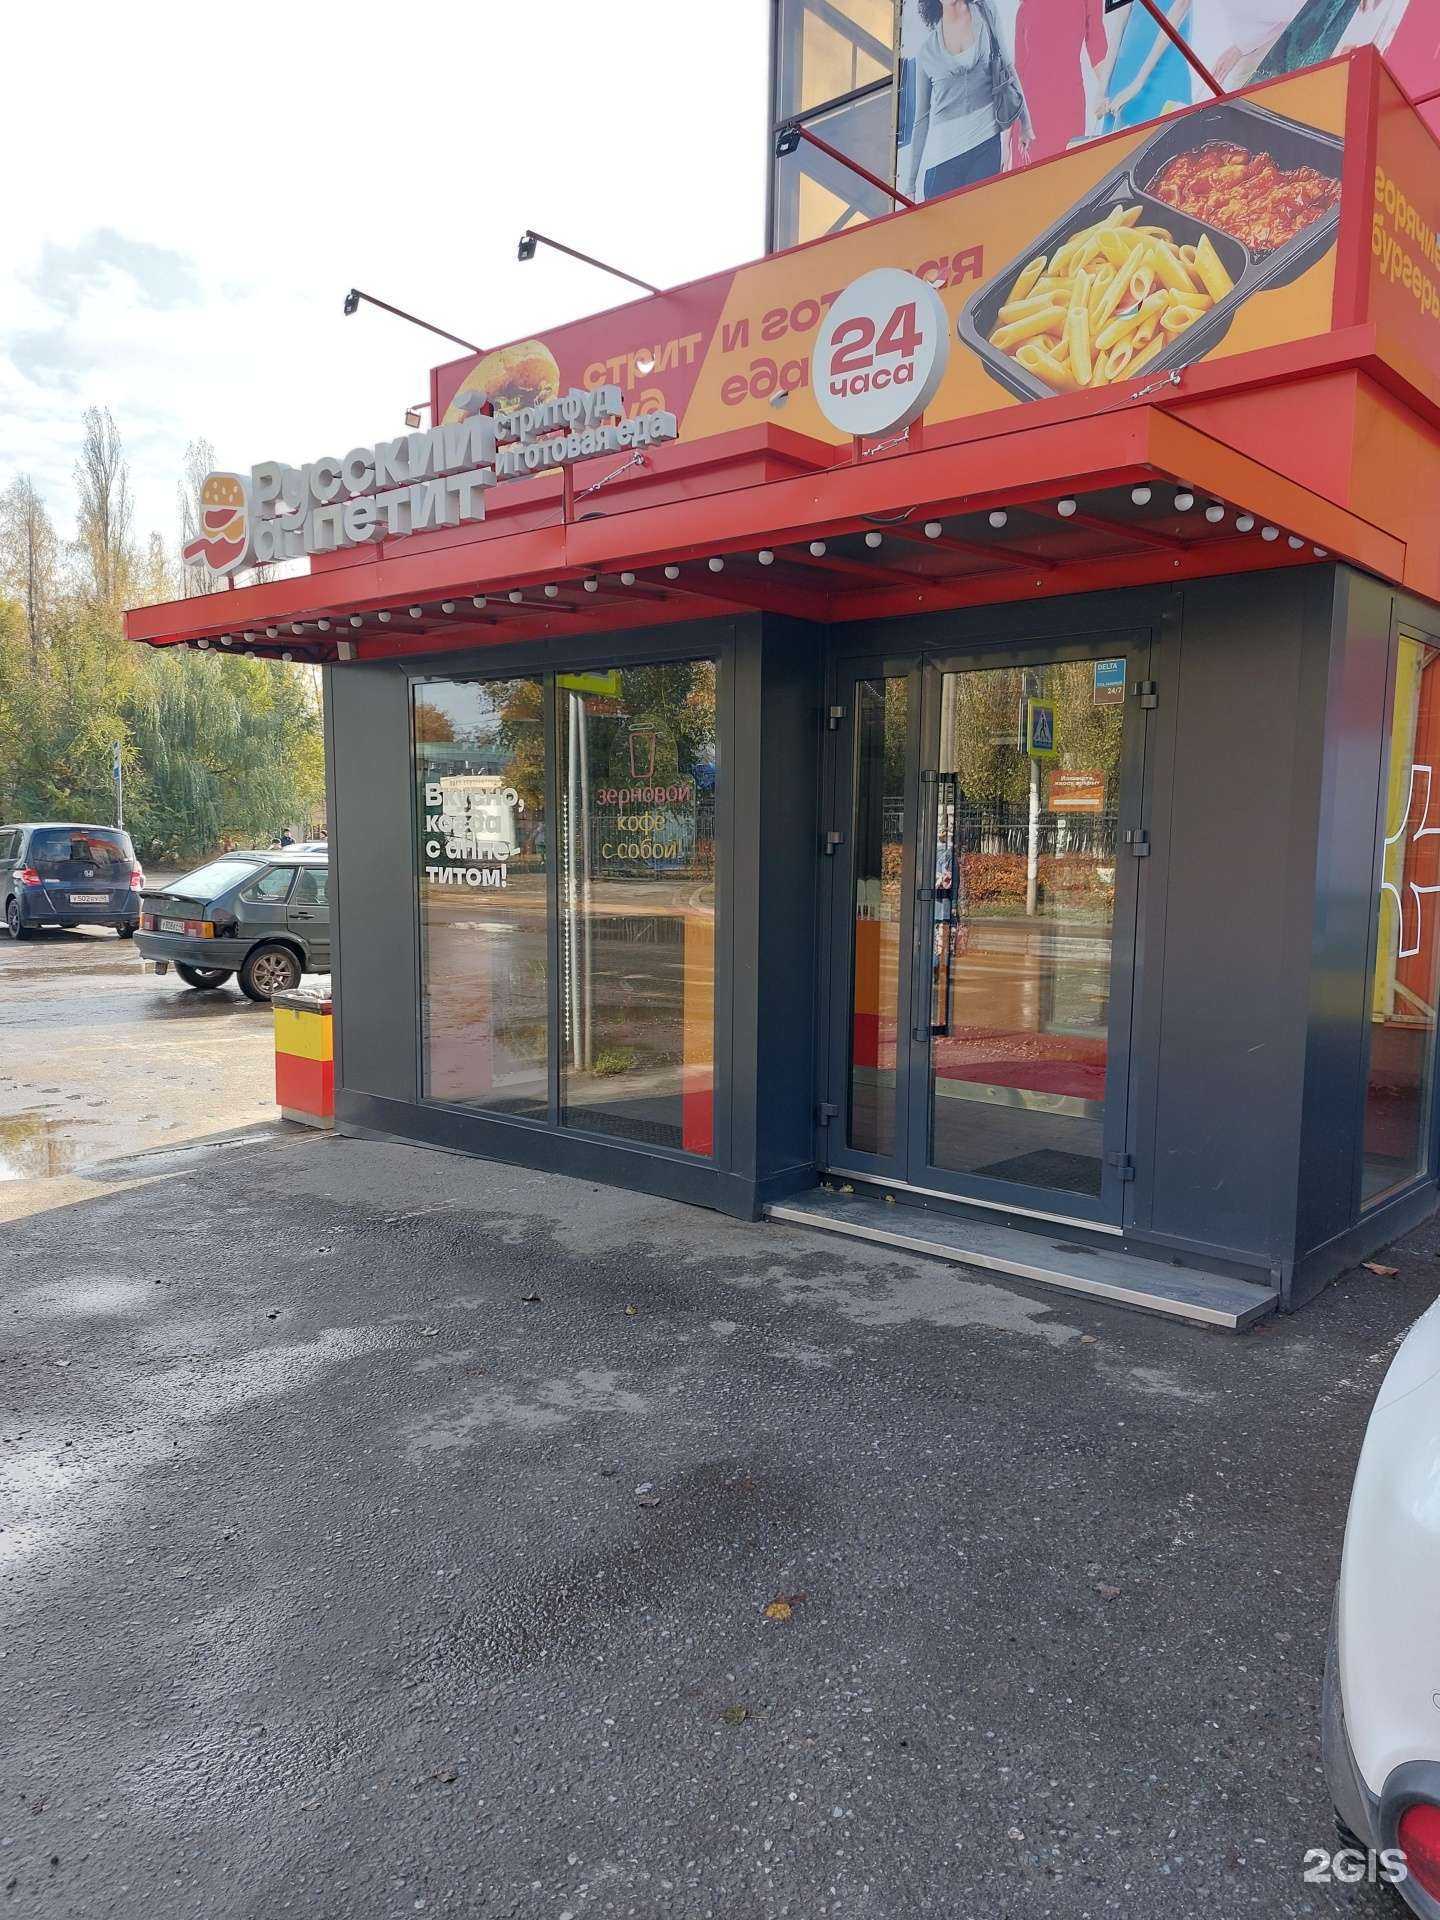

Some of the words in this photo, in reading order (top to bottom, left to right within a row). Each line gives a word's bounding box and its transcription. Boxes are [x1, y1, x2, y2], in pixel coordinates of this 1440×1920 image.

[831, 302, 923, 376] 24
[583, 332, 702, 392] стрит
[721, 357, 809, 406] еда
[830, 362, 914, 397] часа
[494, 385, 622, 441] стритфуд
[512, 427, 617, 473] готовая
[616, 411, 677, 449] еда
[1097, 663, 1118, 671] DELTA
[596, 782, 691, 811] зерновой
[617, 810, 666, 836] кофе
[426, 840, 441, 858] с
[602, 843, 613, 859] с
[425, 863, 507, 888] титом!
